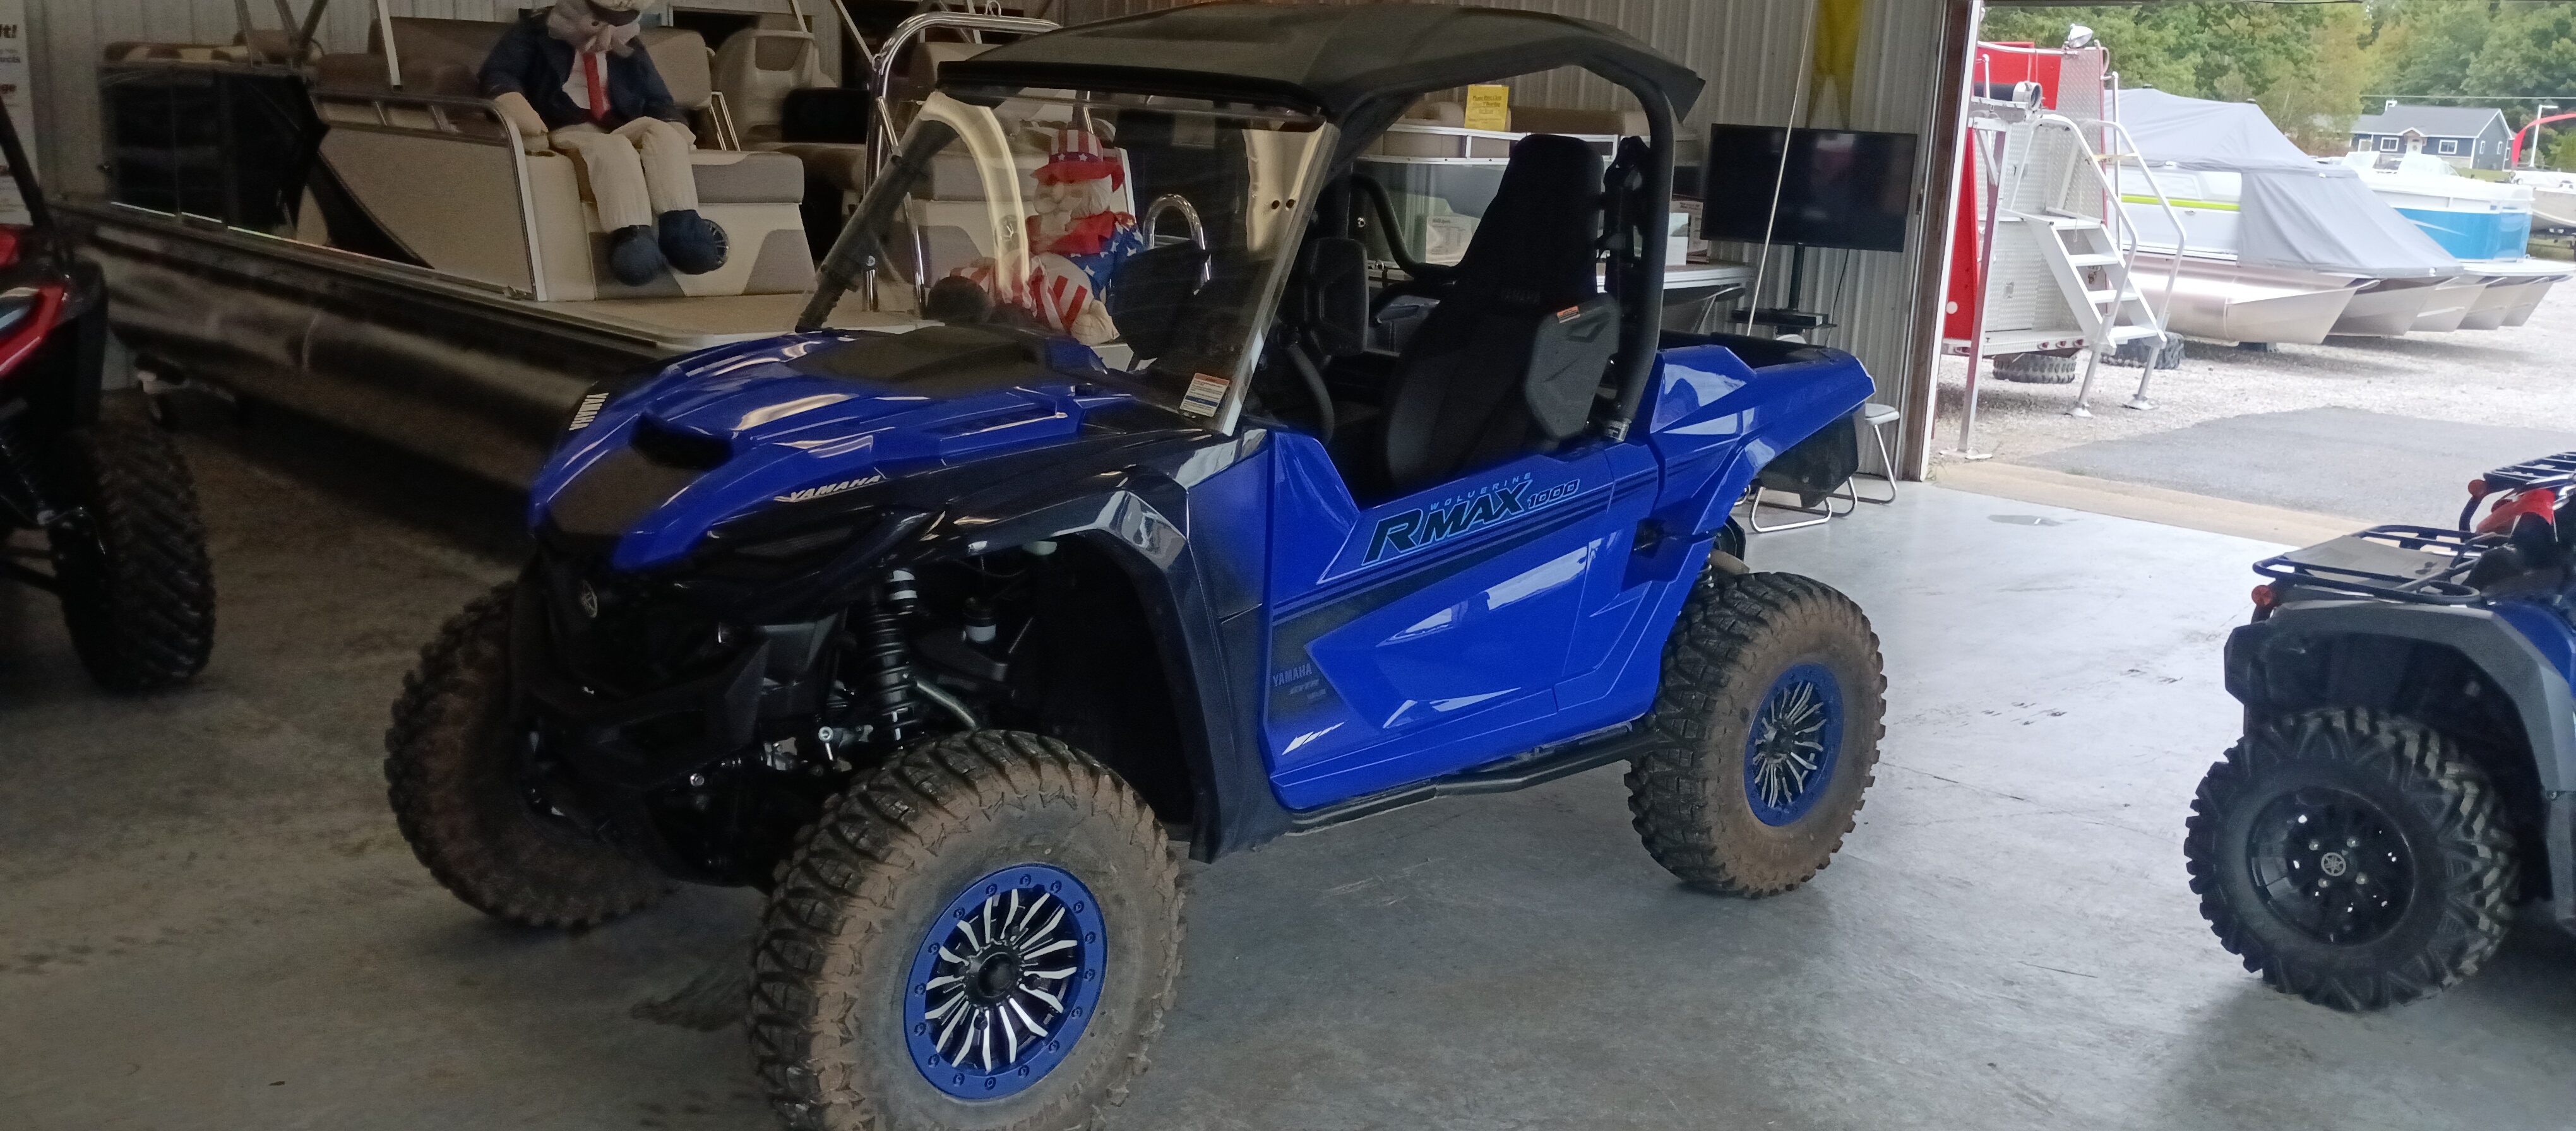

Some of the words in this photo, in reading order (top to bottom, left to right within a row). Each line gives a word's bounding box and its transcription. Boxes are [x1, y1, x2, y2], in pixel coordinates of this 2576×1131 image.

[569, 393, 609, 430] YAMAHA
[790, 475, 881, 502] YAMAHA
[1361, 480, 1533, 566] RMAX
[1528, 478, 1580, 509] 1000
[1272, 663, 1313, 687] YAMAHA
